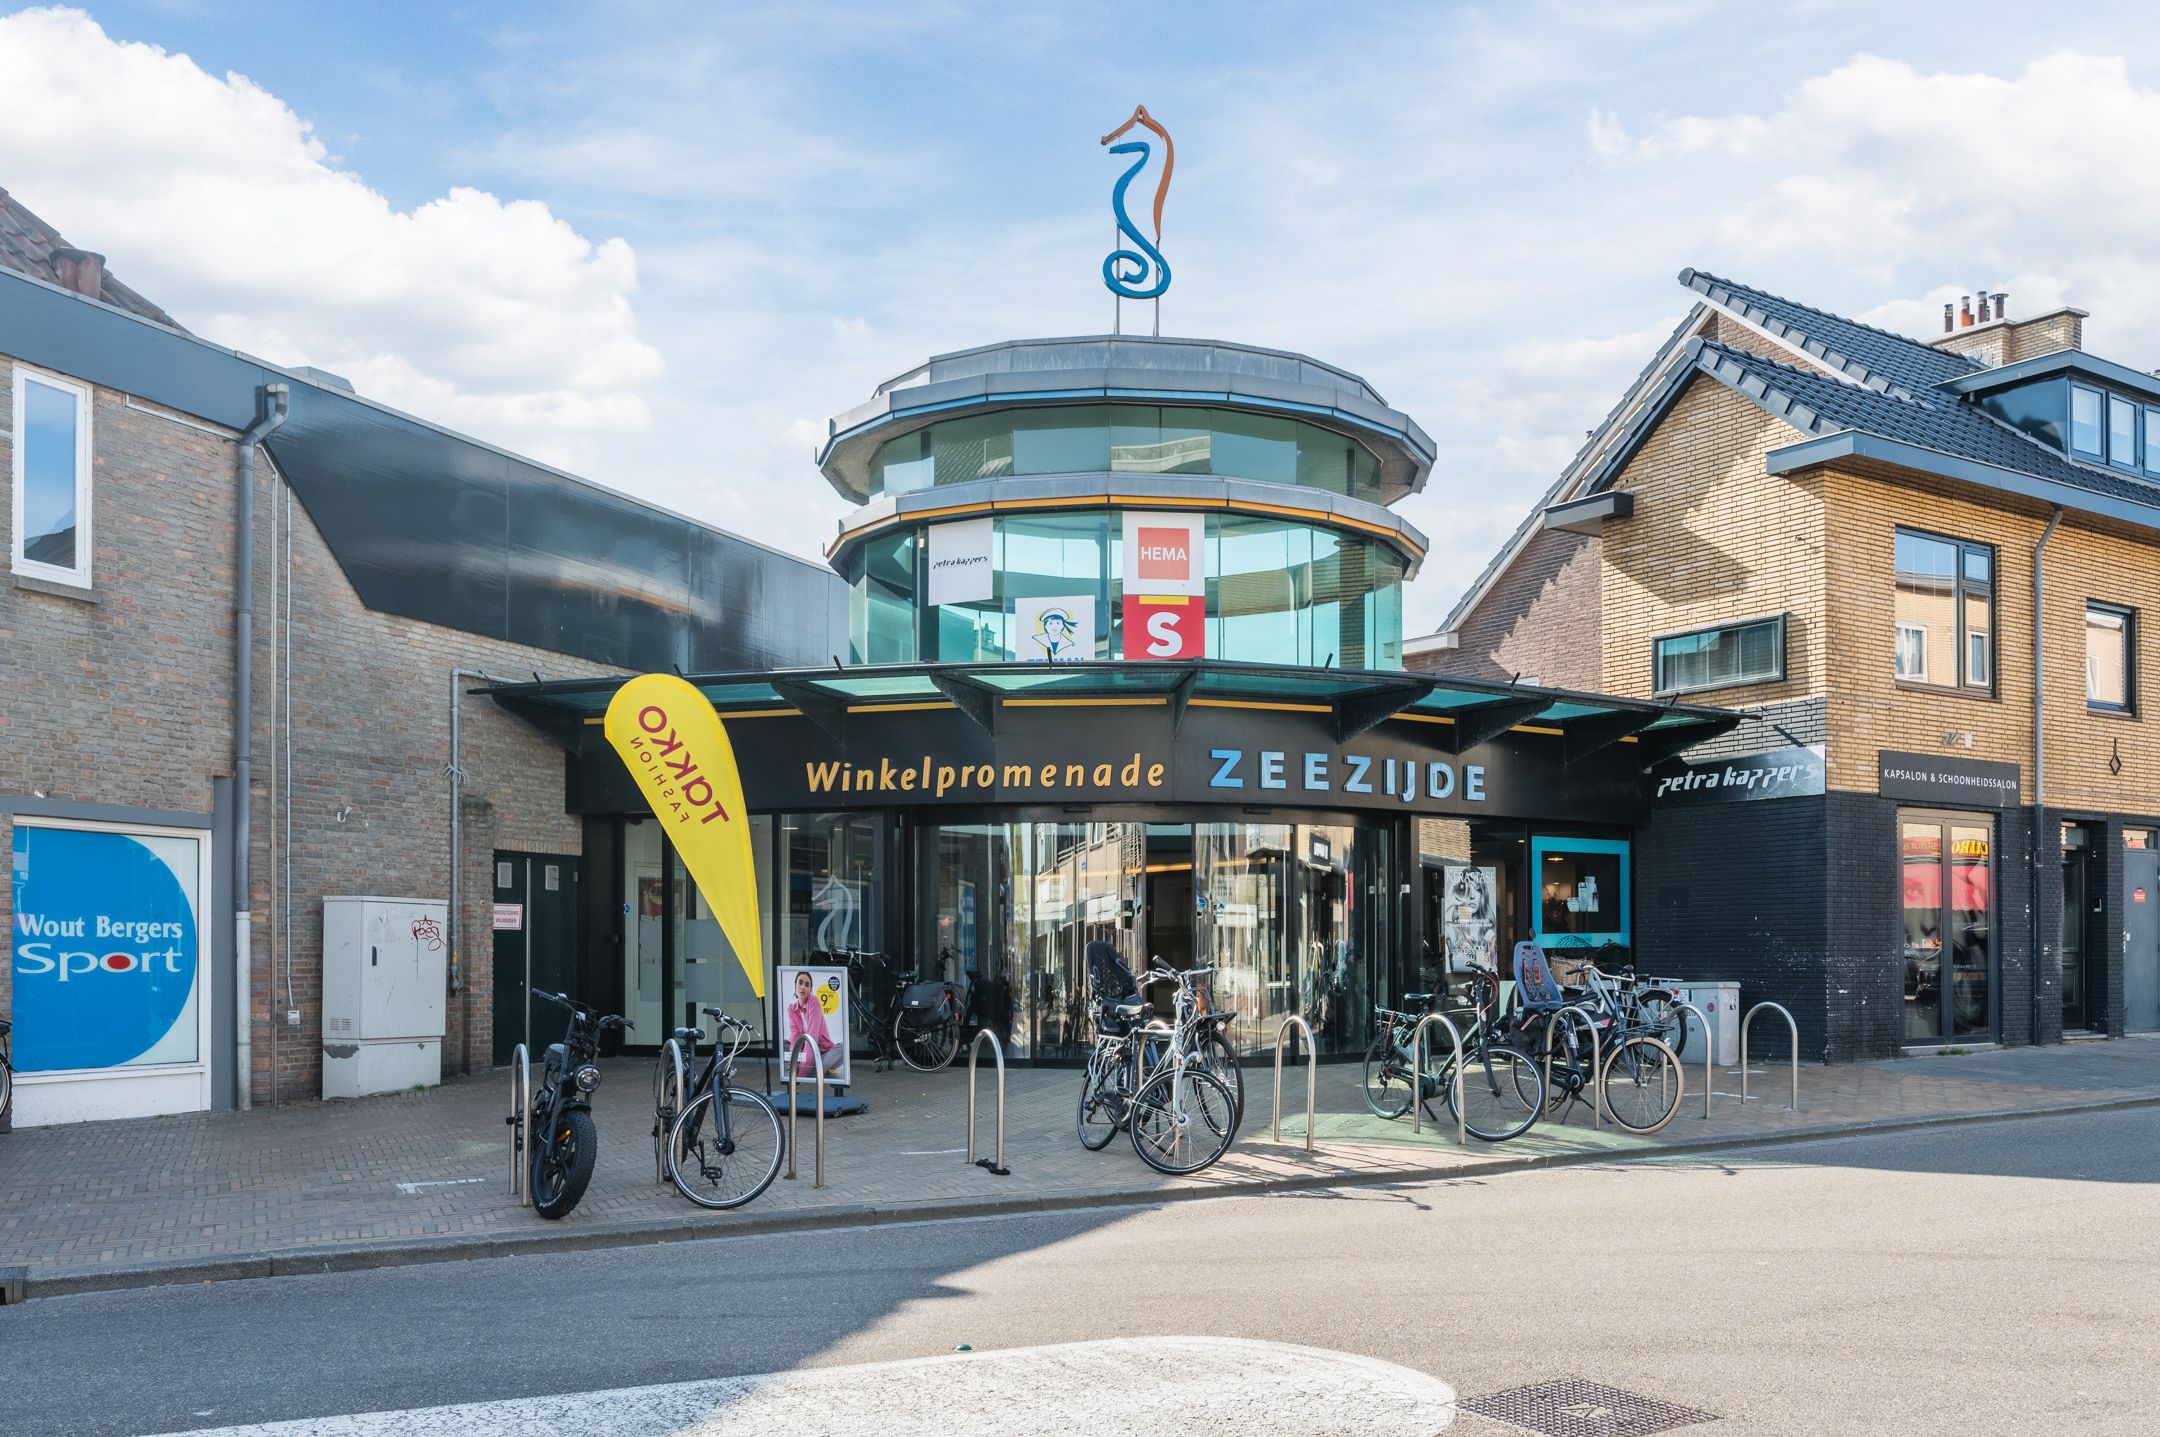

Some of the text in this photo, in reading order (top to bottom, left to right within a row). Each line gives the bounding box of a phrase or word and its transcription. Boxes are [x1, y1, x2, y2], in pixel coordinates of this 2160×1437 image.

[1140, 546, 1187, 561] HEMA
[1146, 611, 1183, 657] S
[806, 749, 1486, 802] Winkelpromenade ZEEZIJDE
[1884, 768, 2017, 790] KAPSALON & SCHOONHEIDSSALON
[18, 914, 183, 944] Wout Bergers
[16, 942, 183, 982] Sport
